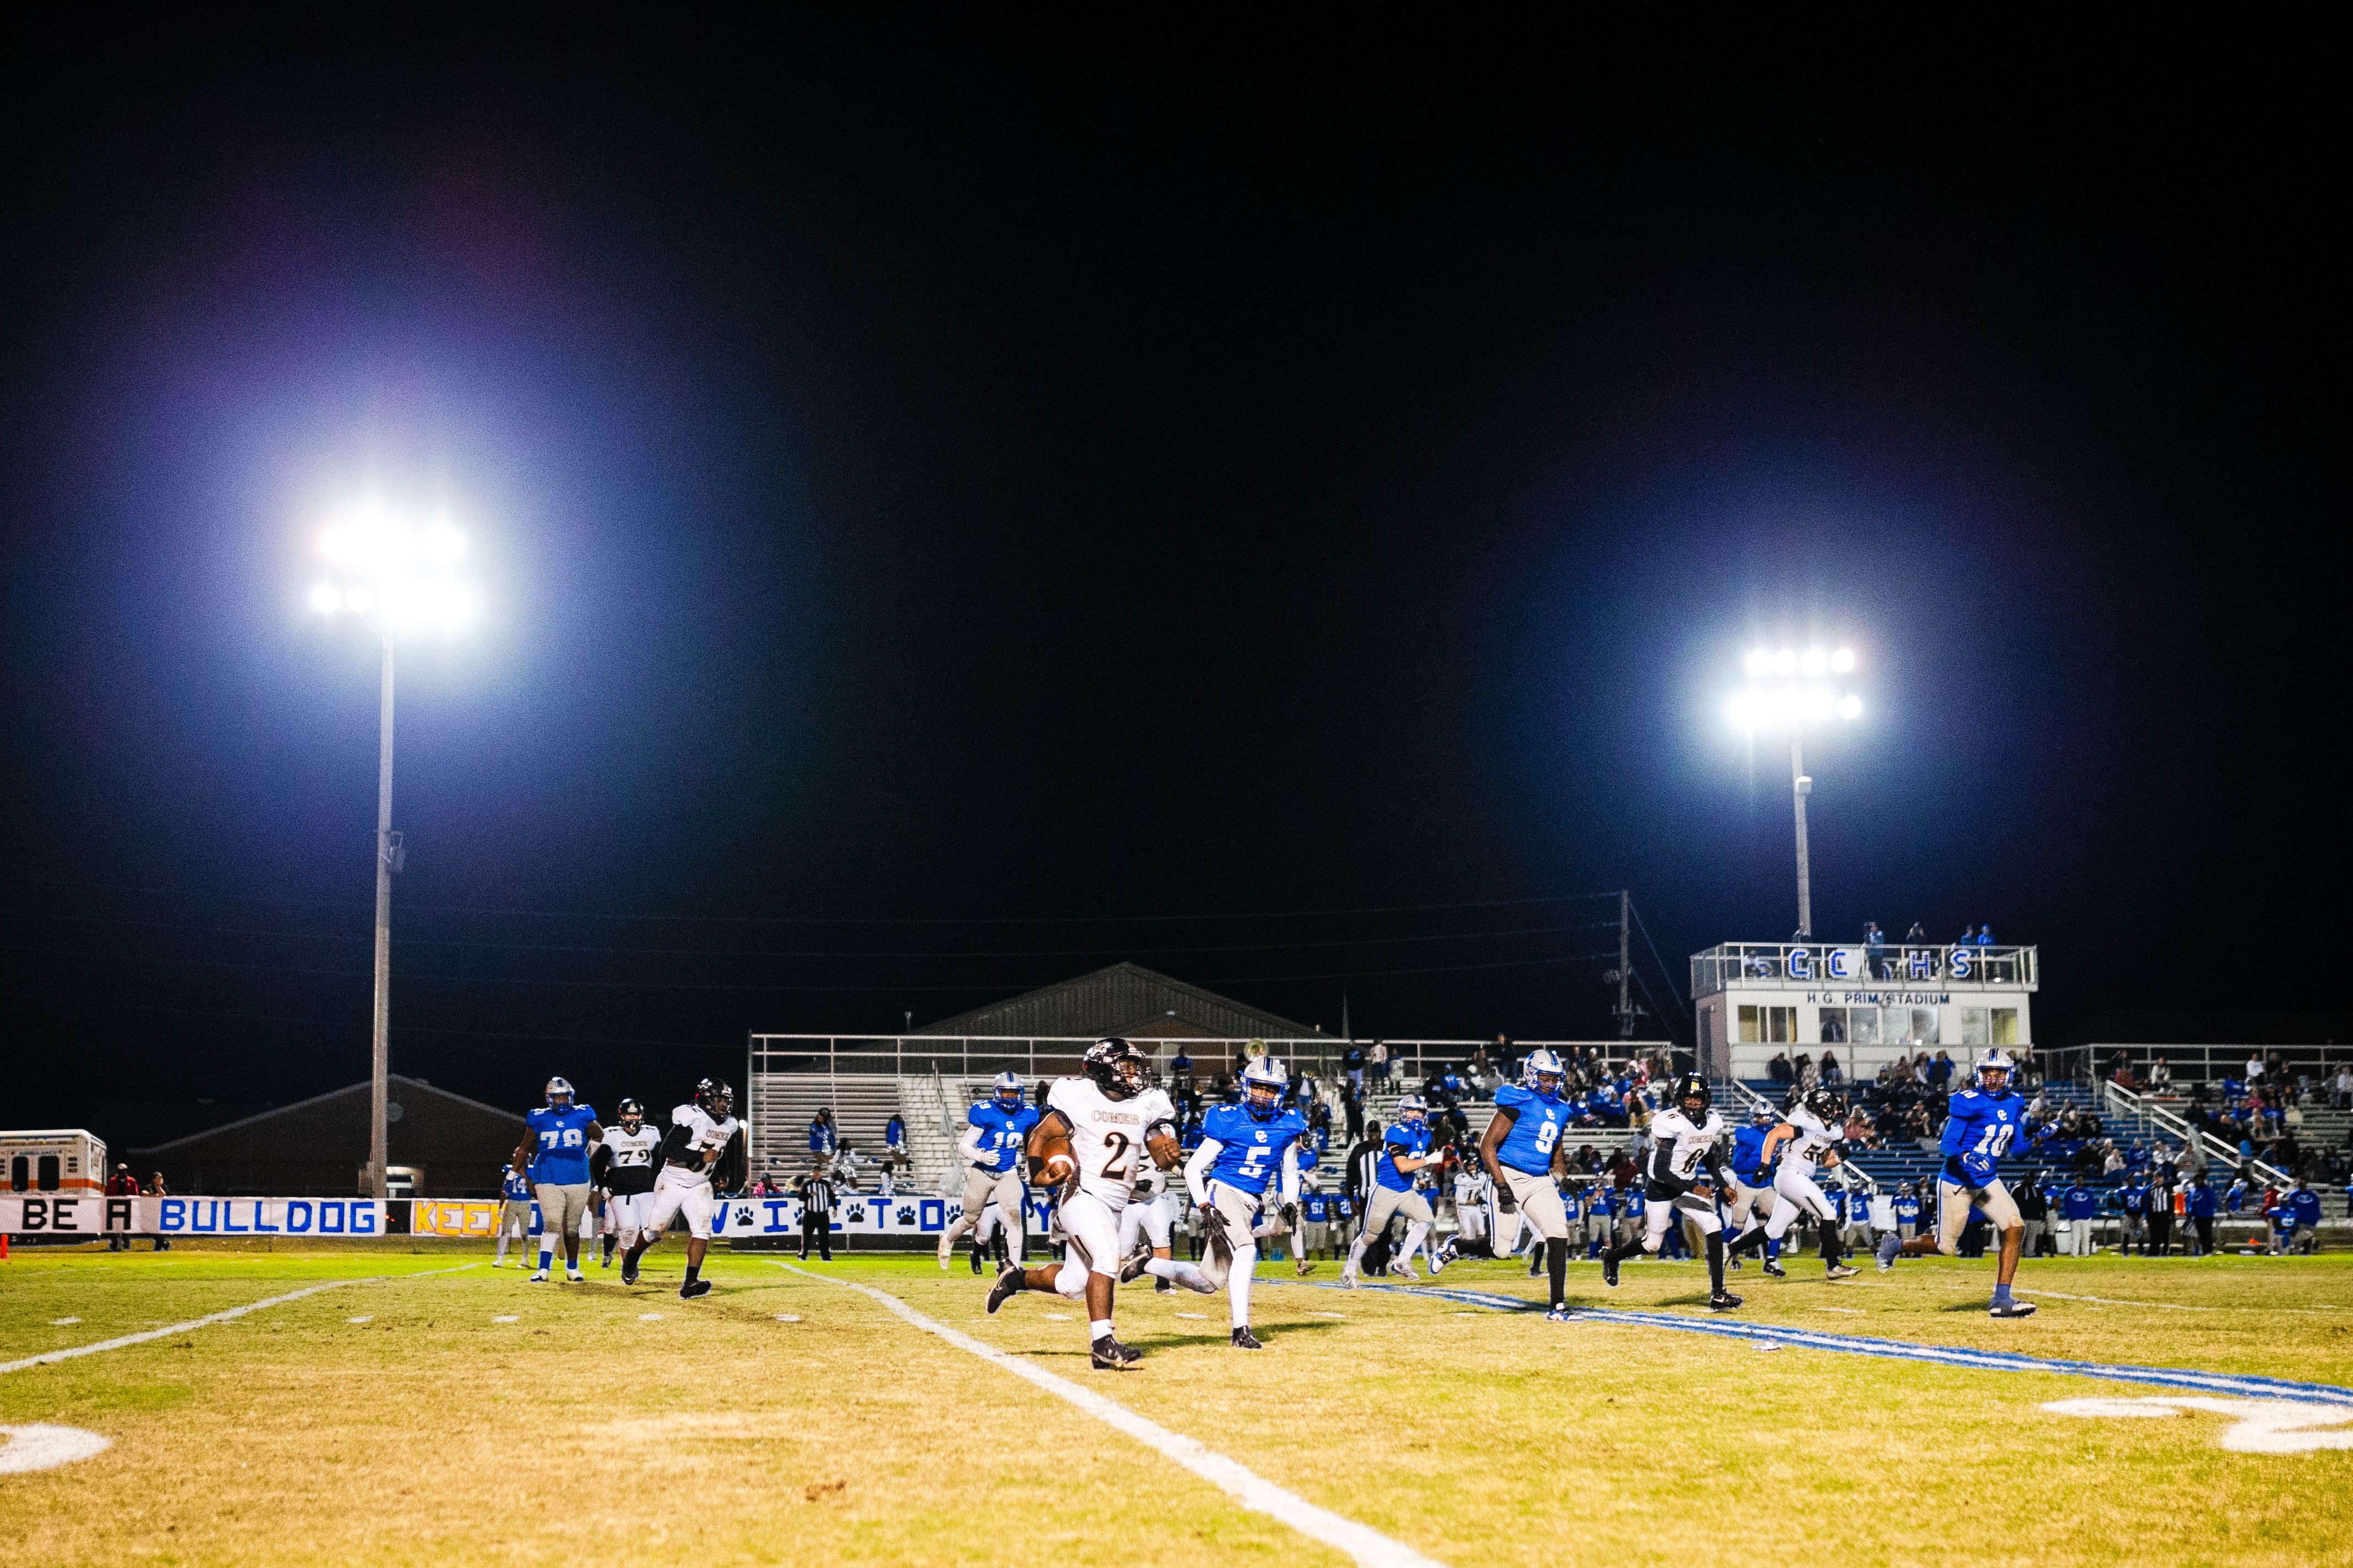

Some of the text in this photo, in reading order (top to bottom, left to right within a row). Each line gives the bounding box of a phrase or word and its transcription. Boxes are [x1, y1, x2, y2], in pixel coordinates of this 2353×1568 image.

[1844, 993, 1878, 1004] PRIM
[1885, 993, 1950, 1005] STADIUM
[1091, 1110, 1140, 1125] COMER
[1535, 1121, 1559, 1154] 9
[1973, 1124, 2014, 1157] 10
[1100, 1132, 1130, 1180] 2
[1238, 1146, 1272, 1179] 5
[22, 1199, 375, 1233] BE A BULLDOG
